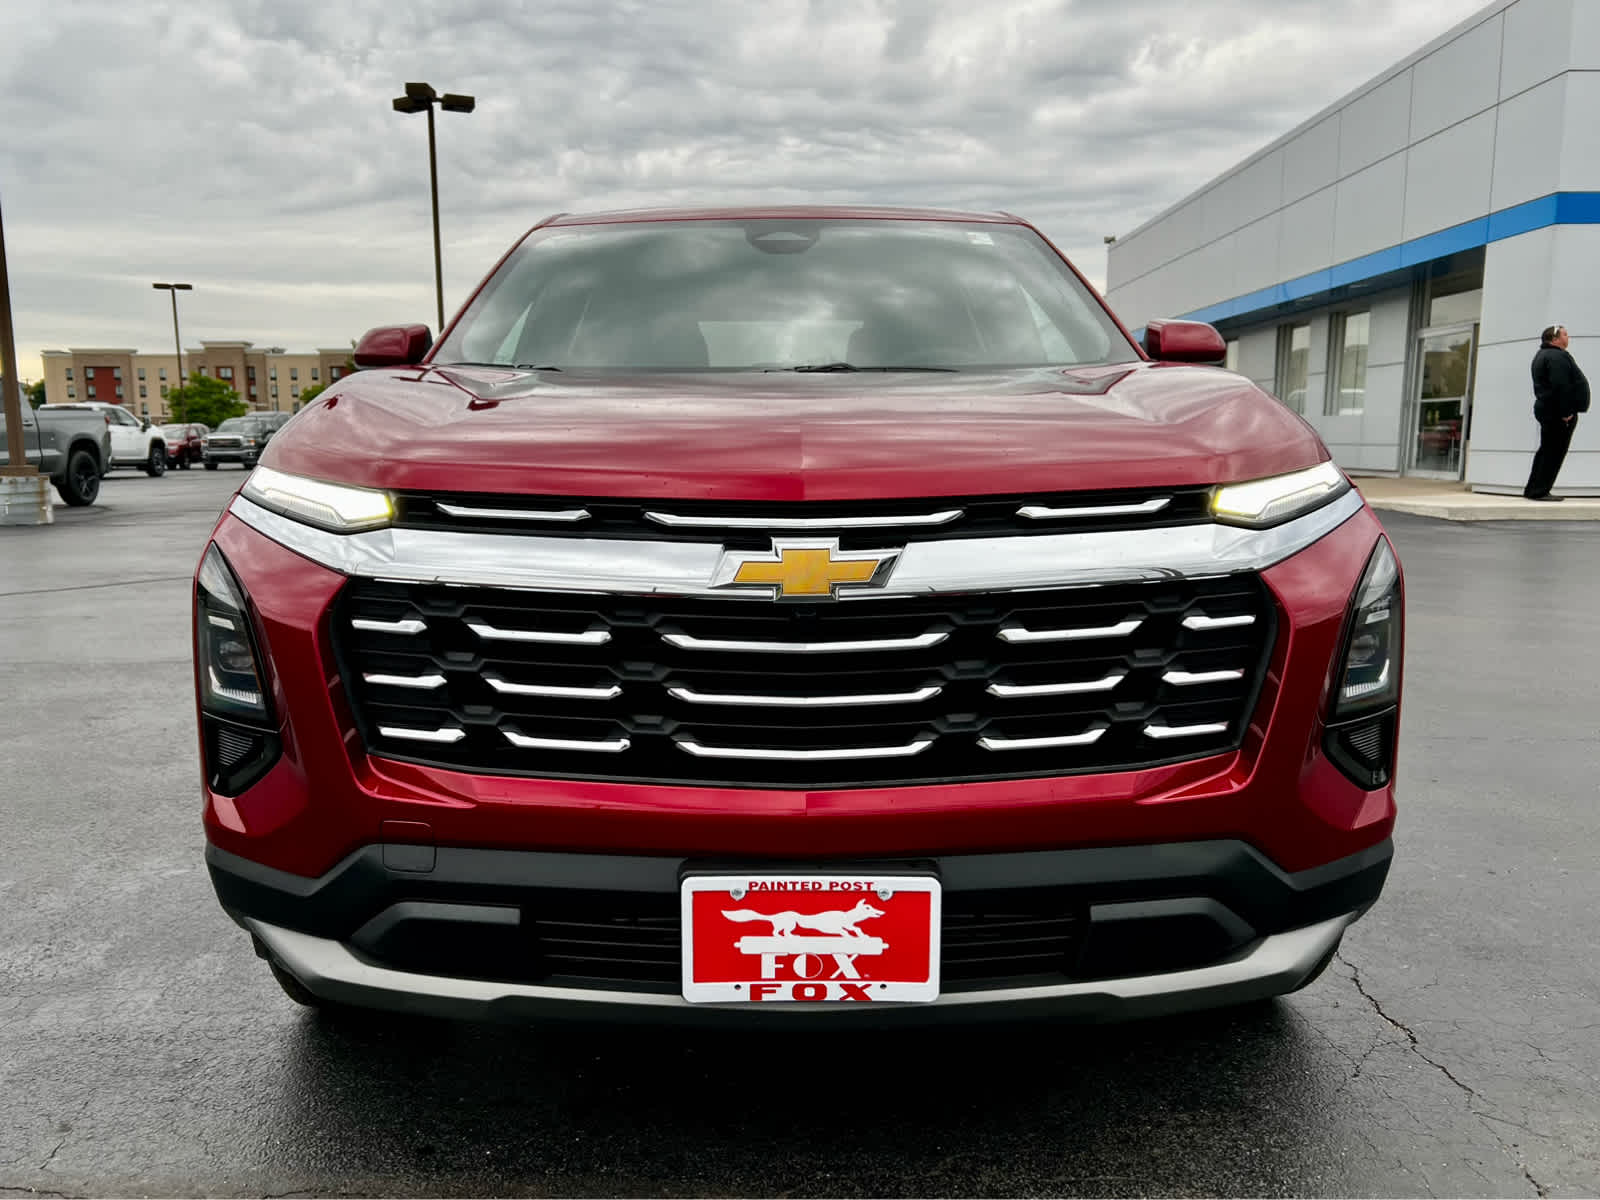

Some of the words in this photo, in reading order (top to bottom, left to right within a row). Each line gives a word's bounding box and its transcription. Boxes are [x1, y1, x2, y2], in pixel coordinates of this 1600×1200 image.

[748, 881, 822, 891] PAINTED
[829, 881, 874, 891] POST
[761, 952, 861, 979] FOX
[749, 983, 872, 1001] FOX
